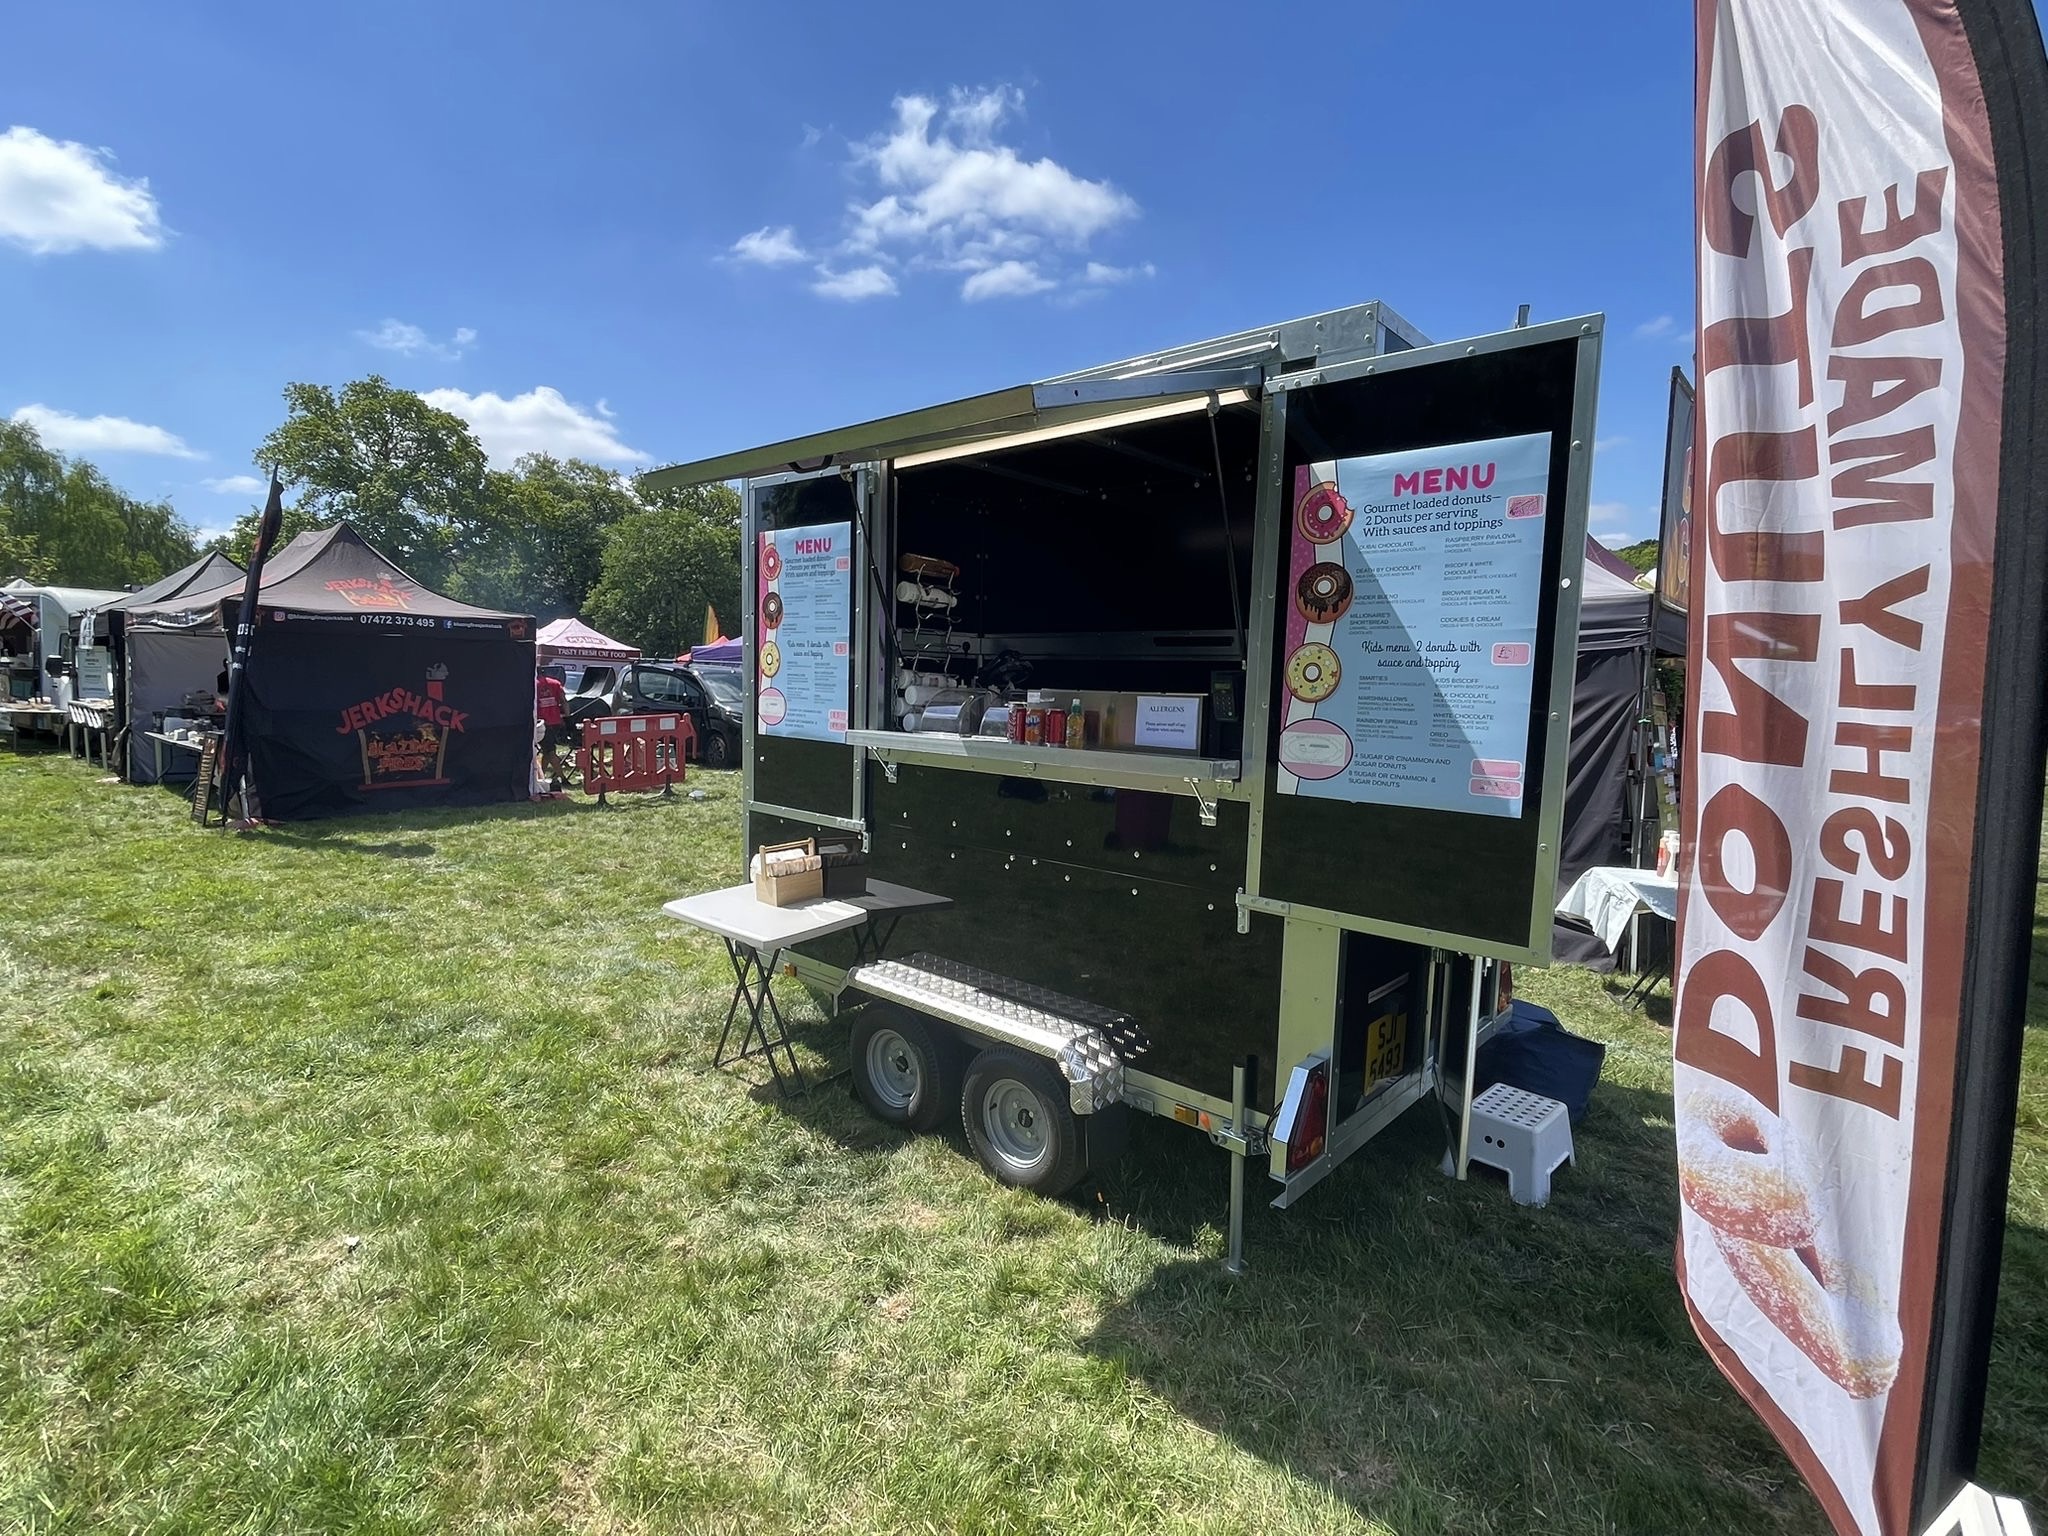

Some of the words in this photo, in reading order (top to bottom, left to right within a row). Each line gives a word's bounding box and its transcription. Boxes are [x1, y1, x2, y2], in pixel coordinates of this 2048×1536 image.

[1393, 462, 1496, 497] MENU
[1363, 501, 1411, 514] Gourmet
[1412, 497, 1449, 510] loaded
[1365, 516, 1372, 526] 2
[1374, 513, 1412, 525] Donuts
[1414, 512, 1433, 523] per
[1435, 507, 1478, 519] serving
[1363, 526, 1390, 537] With
[1392, 525, 1428, 535] sauces
[1429, 521, 1450, 532] and
[1453, 518, 1503, 531] toppings
[795, 537, 832, 555] MENU
[1378, 541, 1414, 549] CHOCOLATE
[1445, 535, 1484, 543] RASPBERRY
[324, 578, 414, 601] JERKSHACK
[360, 615, 393, 625] 07472
[395, 615, 414, 626] 373
[416, 617, 435, 627] 495
[558, 648, 577, 656] TASTY
[598, 650, 610, 658] CAT
[1361, 640, 1384, 654] Kids
[1385, 644, 1411, 652] menu
[1416, 640, 1423, 652] 2
[1425, 641, 1458, 652] donuts
[1460, 640, 1482, 652] with
[1377, 658, 1404, 667] sauce
[1404, 656, 1424, 667] and
[1424, 656, 1461, 673] topping
[335, 687, 470, 735] JERKSHACK
[1378, 762, 1407, 770] DONUTS
[1396, 756, 1434, 764] CINAMMON
[1372, 779, 1400, 788] DONUTS
[1389, 773, 1428, 782] CINAMMON
